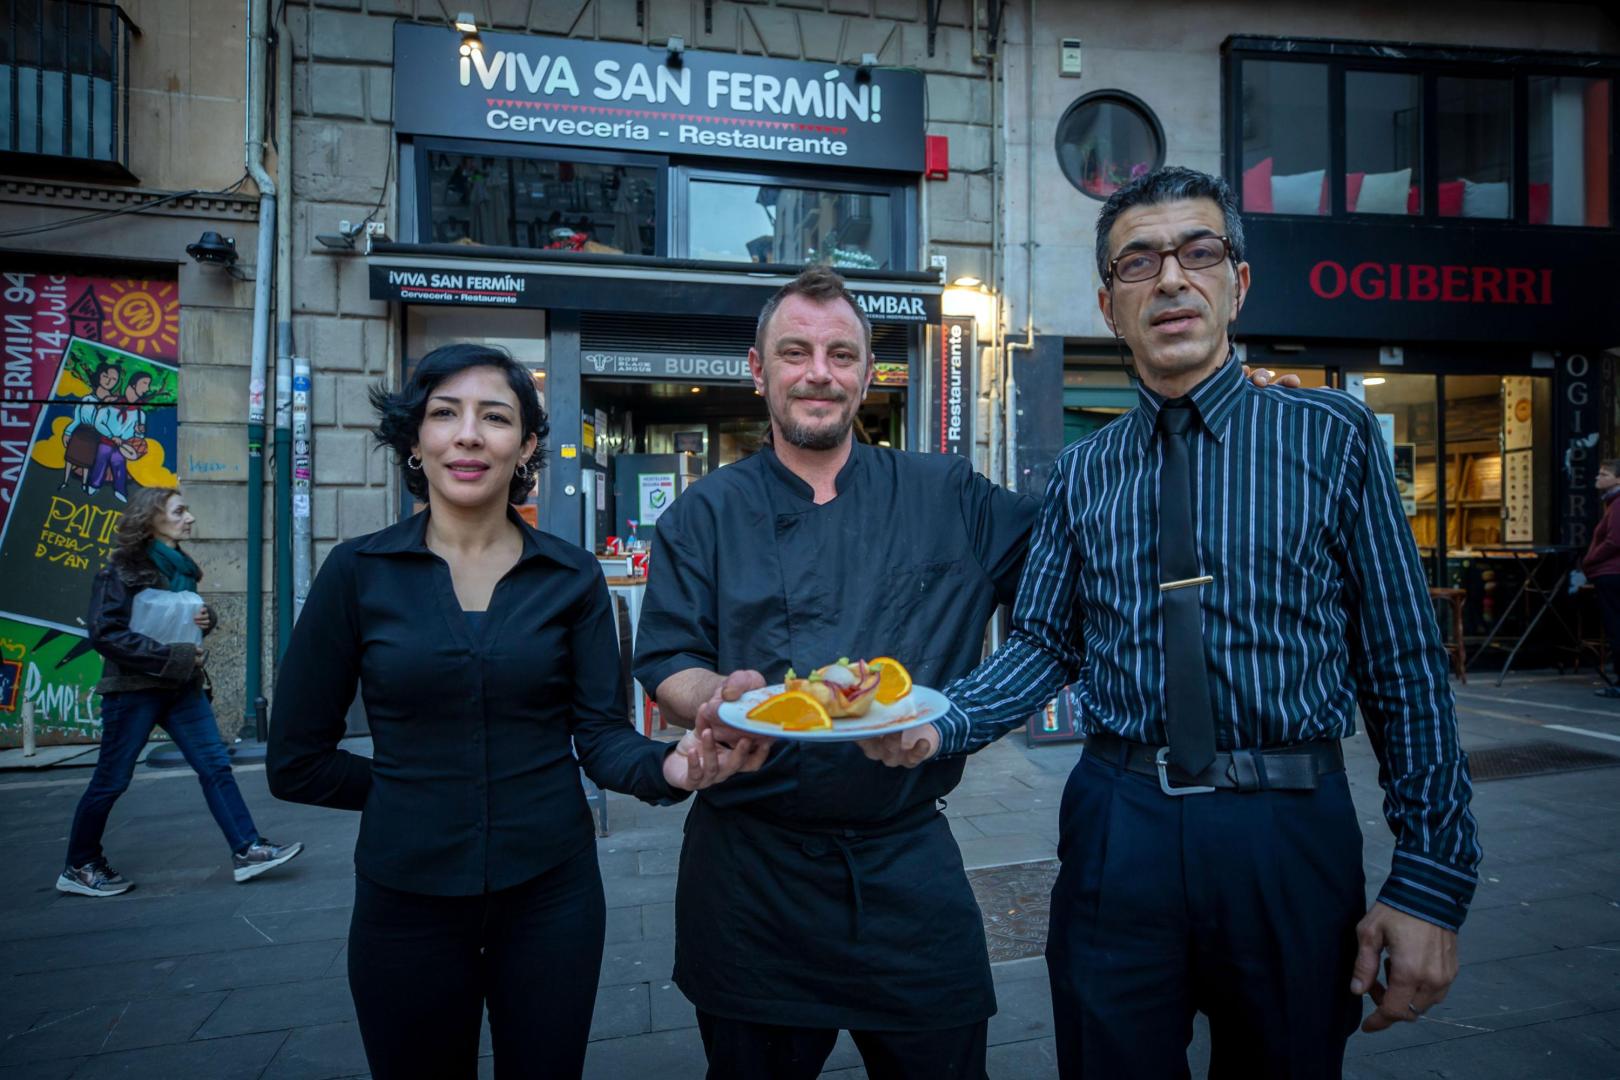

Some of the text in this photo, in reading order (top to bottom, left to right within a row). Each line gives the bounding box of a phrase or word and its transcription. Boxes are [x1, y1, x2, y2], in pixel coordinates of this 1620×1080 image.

[459, 44, 882, 123] ¡VIVA SAN FERMÍN!
[486, 109, 649, 140] Cervecería
[679, 124, 848, 156] Restaurante
[3, 272, 35, 303] 94
[401, 290, 452, 300] Cervecería
[461, 294, 517, 304] Restaurante
[431, 274, 462, 289] SAN
[467, 275, 525, 291] FERMÍN!
[1309, 260, 1552, 304] OGIBERRI
[851, 294, 926, 315] AMBAR
[35, 331, 69, 360] 14
[948, 325, 961, 440] Restaurante
